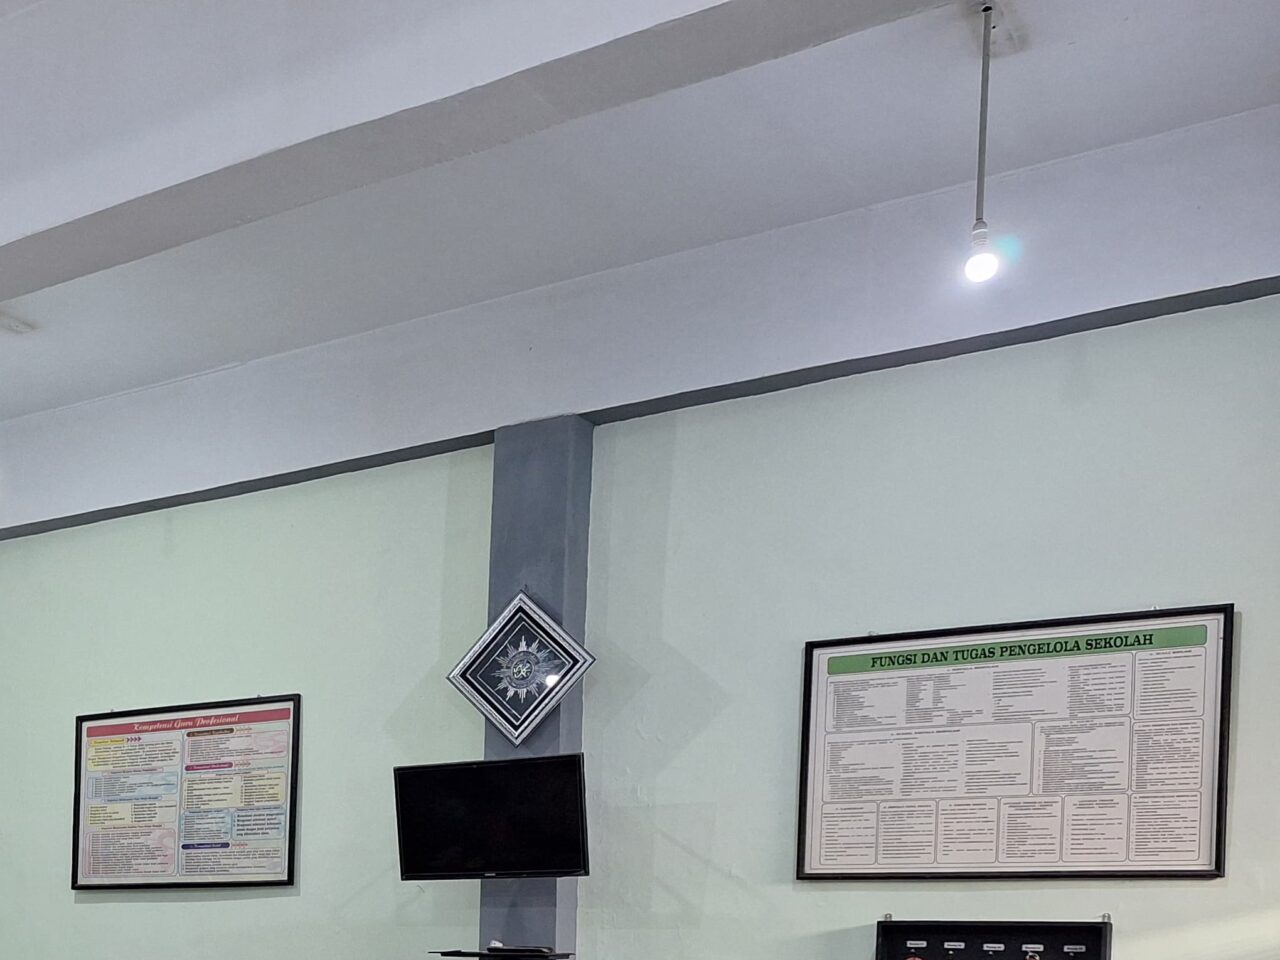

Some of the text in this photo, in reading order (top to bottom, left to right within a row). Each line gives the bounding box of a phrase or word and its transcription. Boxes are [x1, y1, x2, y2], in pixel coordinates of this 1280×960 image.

[870, 633, 1154, 668] FUNGSI DAN TUGAS PENGELOLA SEKOLAH
[133, 714, 240, 731] Kompetensi Guru Profesional
